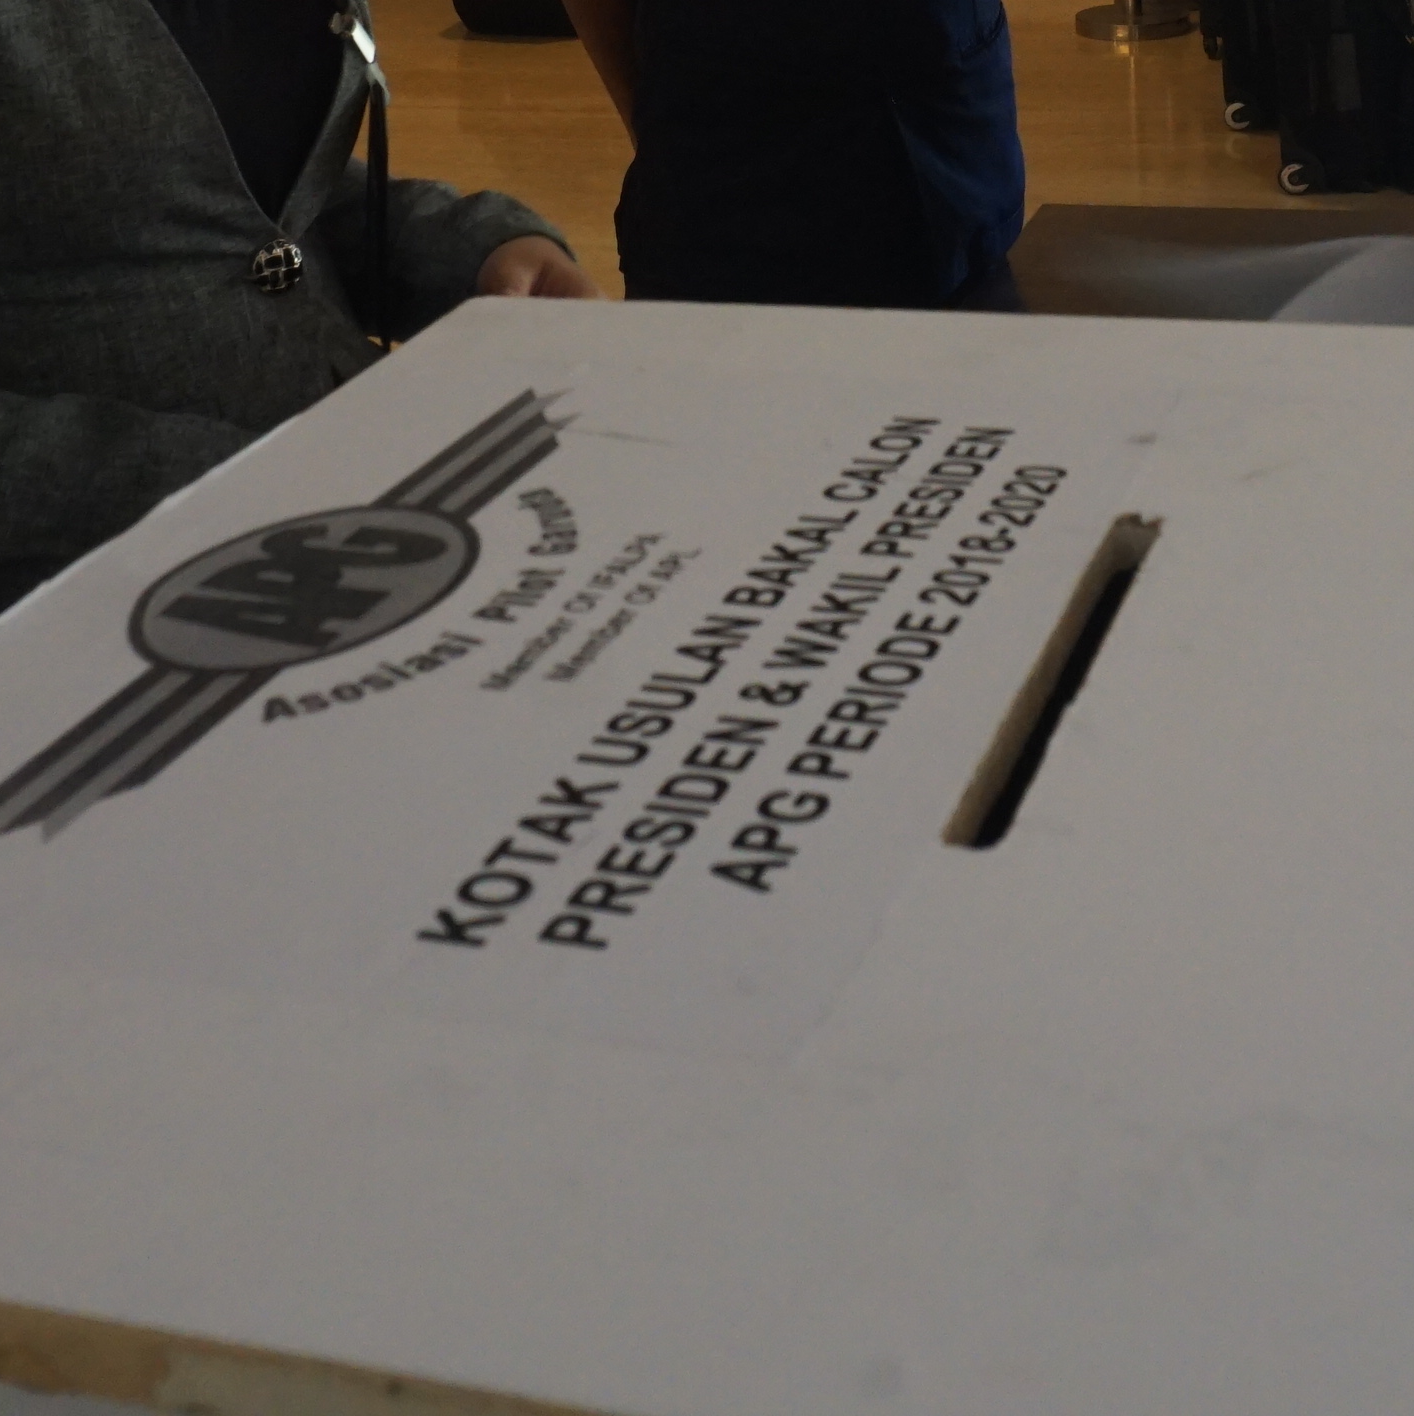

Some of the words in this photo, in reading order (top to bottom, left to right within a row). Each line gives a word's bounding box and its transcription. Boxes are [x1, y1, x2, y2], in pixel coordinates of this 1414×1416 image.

[859, 425, 1015, 559] PRESIDEN
[262, 631, 483, 723] Asosiasi
[473, 568, 566, 623] Pilot
[417, 776, 620, 948] KOTAK
[577, 615, 762, 767] USULAN
[722, 509, 859, 608] BAKAL
[823, 416, 941, 502] CALON
[710, 789, 830, 893] APG
[787, 611, 961, 782] PERIODE
[918, 464, 1068, 606] 2018-2020
[738, 680, 810, 707] &
[761, 564, 902, 668] WAKIL
[538, 714, 780, 950] PRESIDEN
